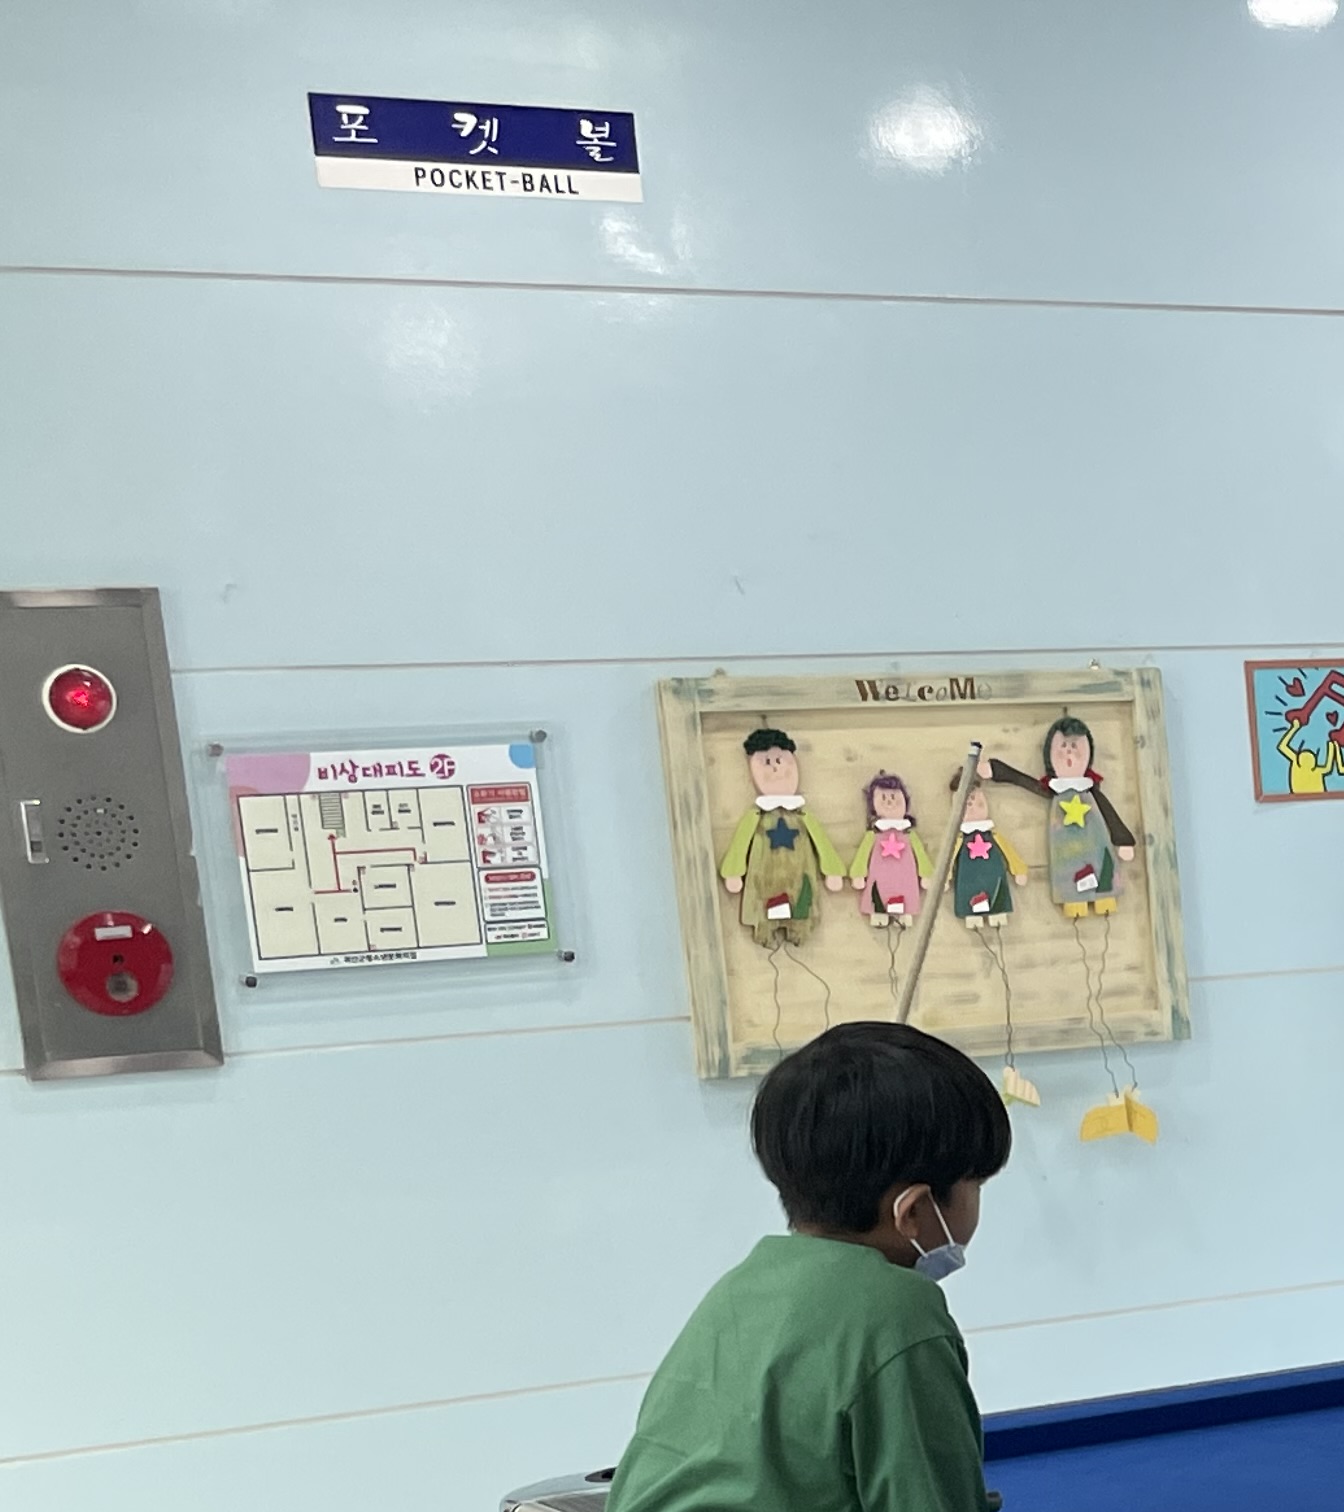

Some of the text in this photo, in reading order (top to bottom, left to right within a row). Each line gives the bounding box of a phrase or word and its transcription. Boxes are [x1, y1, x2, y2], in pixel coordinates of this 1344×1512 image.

[413, 166, 580, 195] POCKET-BALL
[317, 756, 456, 784] 비상대피도 2F
